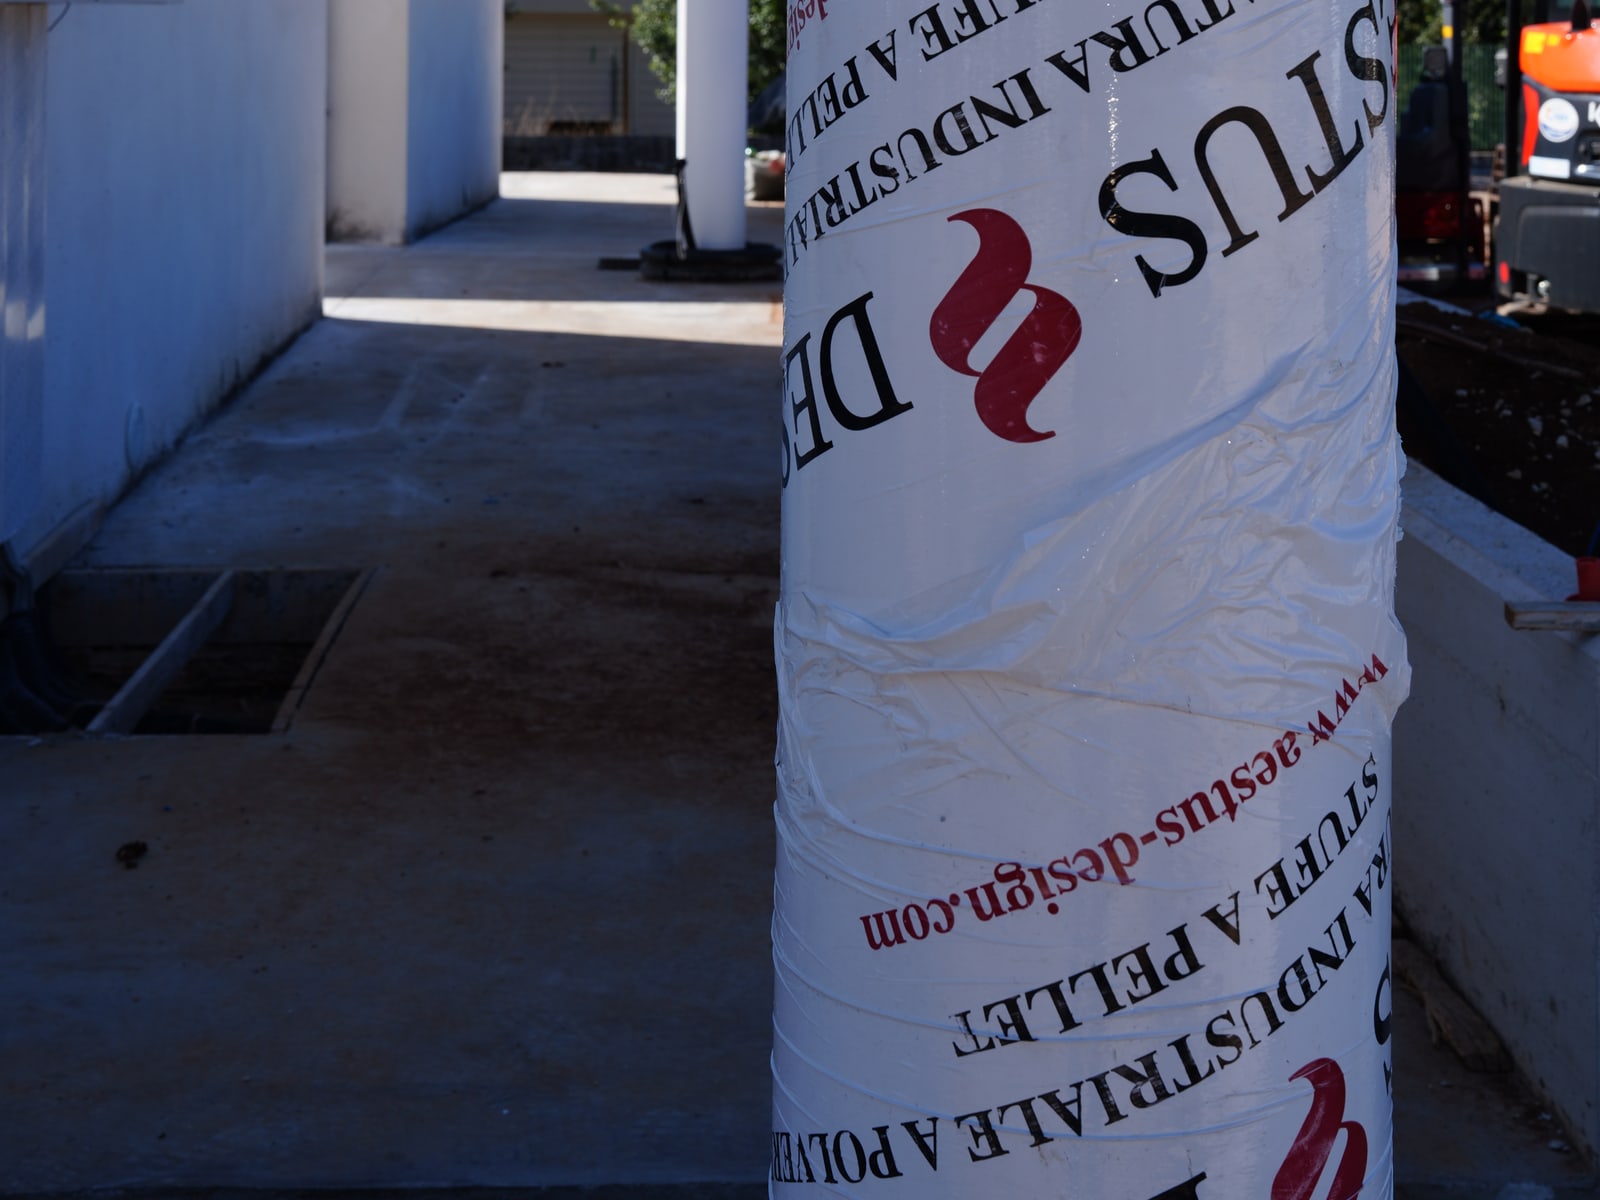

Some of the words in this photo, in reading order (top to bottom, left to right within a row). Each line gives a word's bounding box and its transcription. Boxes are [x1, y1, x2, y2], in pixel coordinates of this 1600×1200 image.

[865, 29, 897, 81] A
[785, 68, 1052, 278] INDUSTRIAL
[859, 653, 1388, 950] wwwaestus-design.com
[1254, 752, 1378, 920] STUFE
[952, 923, 1205, 1057] PELLET
[1200, 891, 1240, 945] A
[954, 906, 1356, 1162] INDUSTRIALE
[900, 1116, 939, 1171] A
